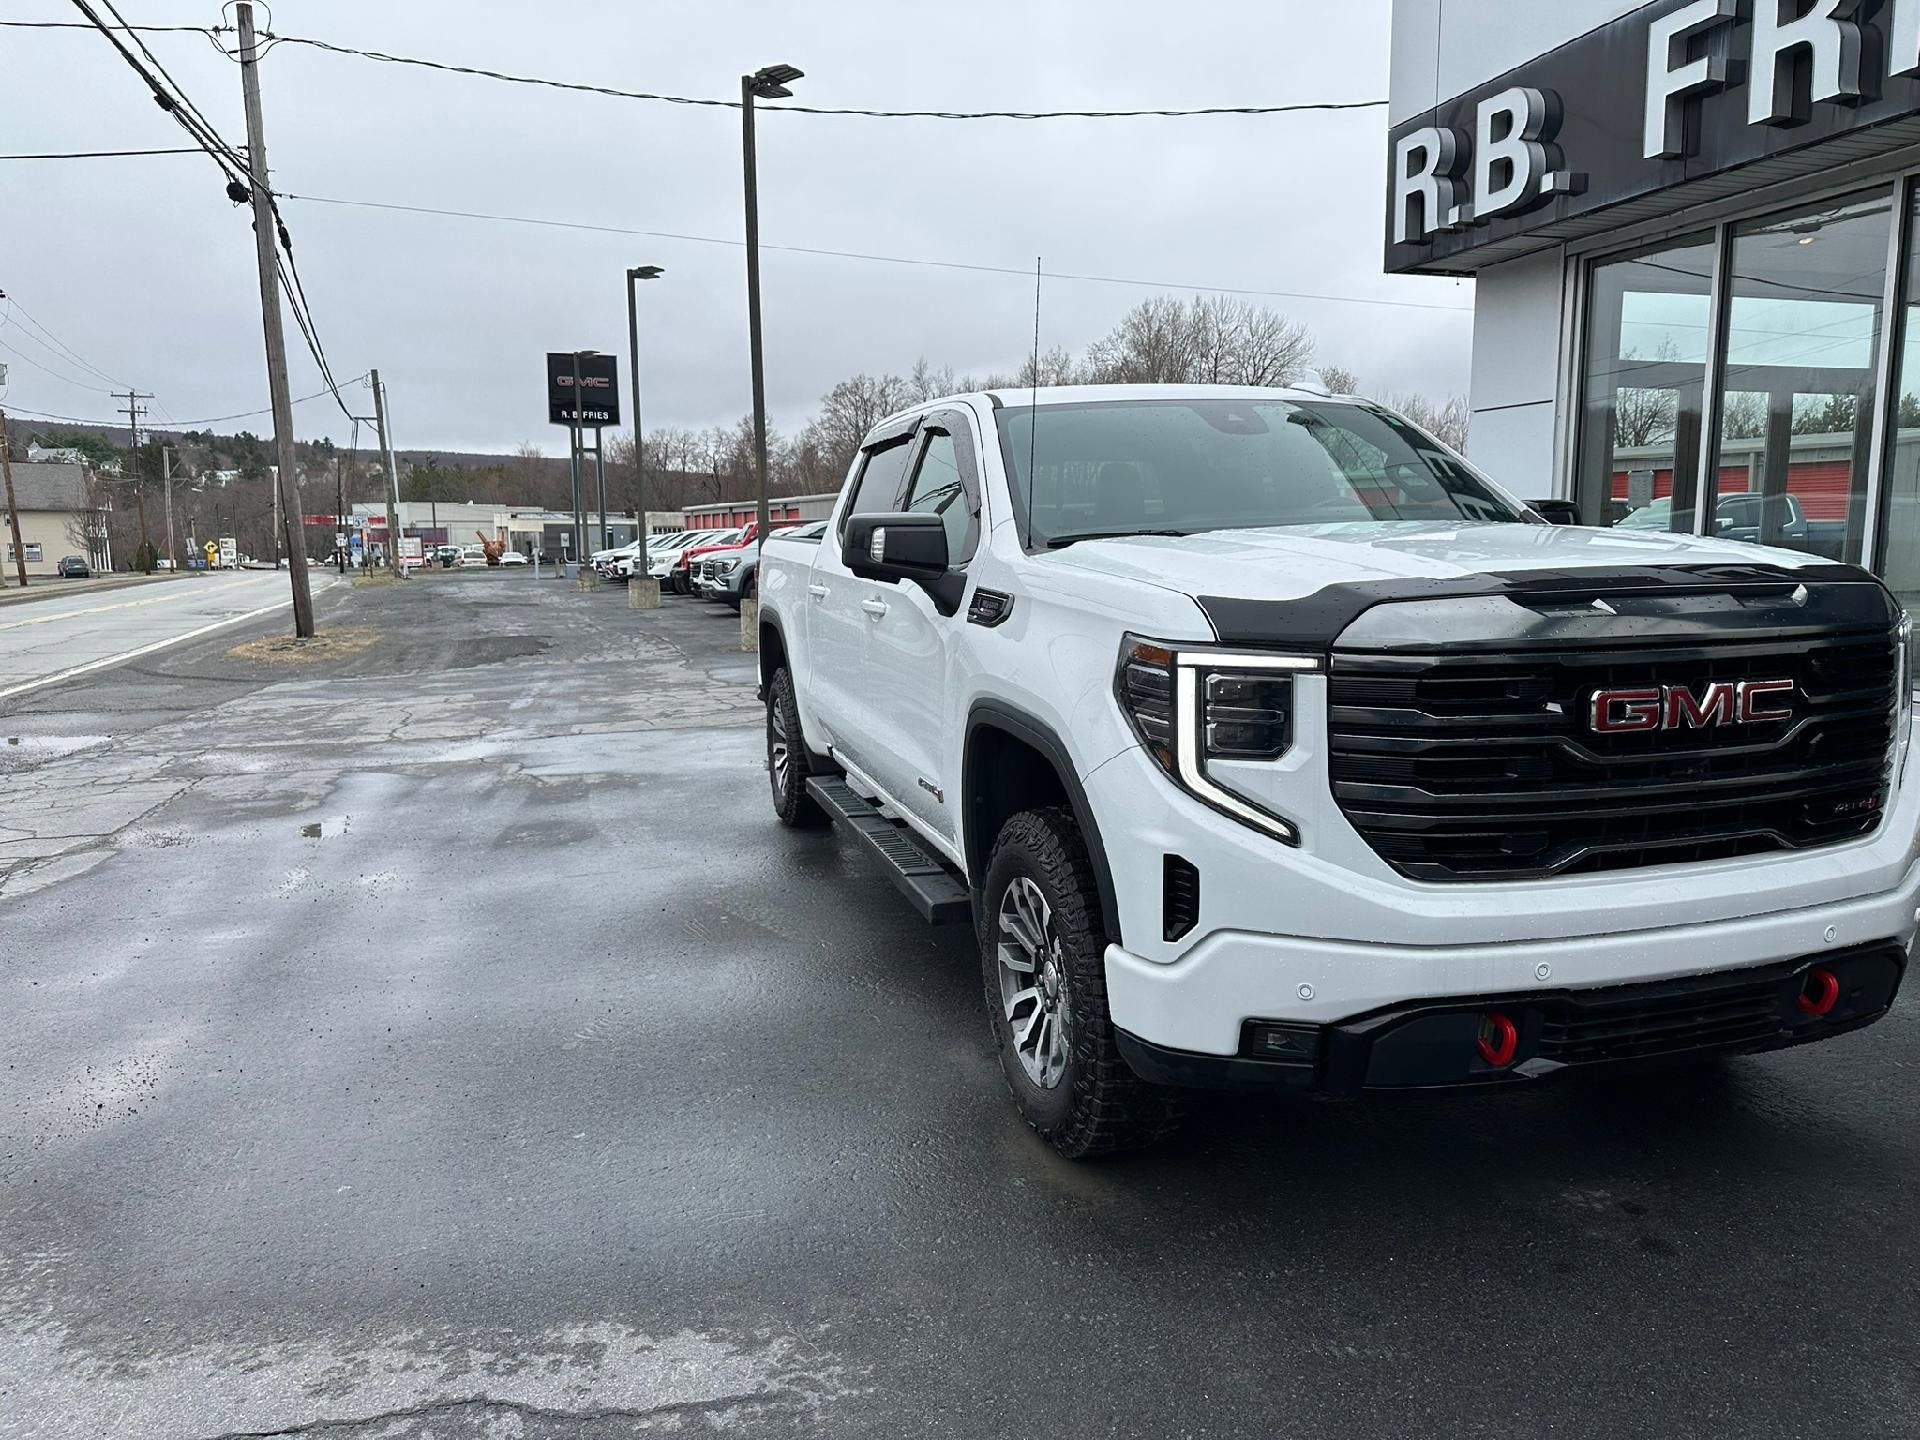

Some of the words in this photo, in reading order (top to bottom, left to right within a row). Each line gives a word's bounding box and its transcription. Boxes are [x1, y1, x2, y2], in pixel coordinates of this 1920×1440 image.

[557, 376, 609, 388] GMC
[583, 411, 609, 420] FRIES
[1591, 679, 1794, 733] GMC
